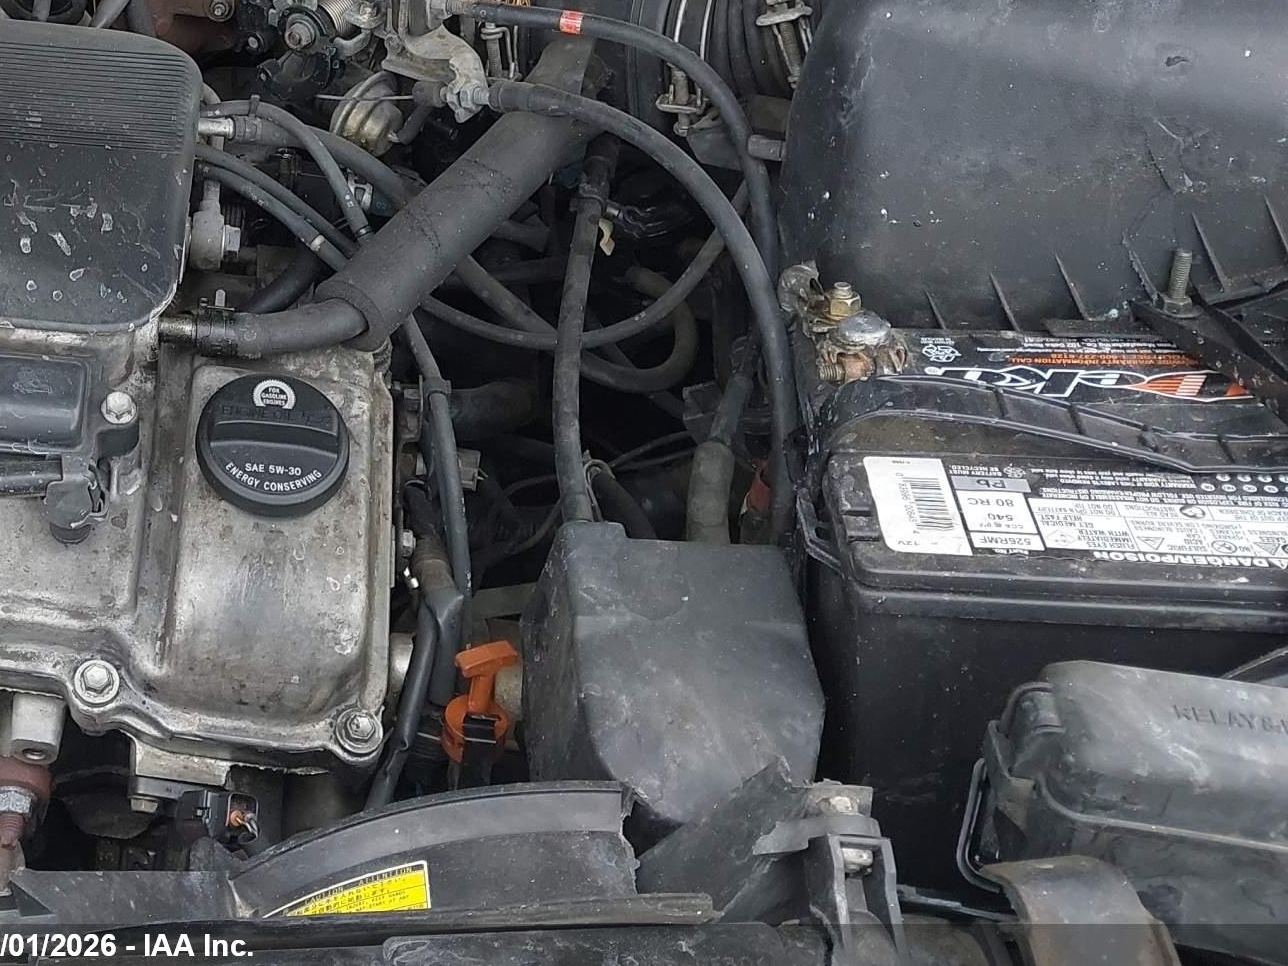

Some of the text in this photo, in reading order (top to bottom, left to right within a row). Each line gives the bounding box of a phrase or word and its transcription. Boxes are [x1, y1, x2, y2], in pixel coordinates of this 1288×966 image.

[261, 392, 287, 400] GASOLINE
[263, 398, 285, 406] ENGINES
[245, 463, 302, 476] SAE 5W-30
[225, 462, 322, 492] ENERGY CONSERVING
[975, 479, 1006, 489] Pb
[967, 498, 1015, 507] 80 RC
[987, 513, 1014, 522] 540
[1077, 535, 1133, 543] IMMEDIATELY
[1093, 551, 1270, 568] DANGER/POISON
[1173, 704, 1257, 730] RELAY
